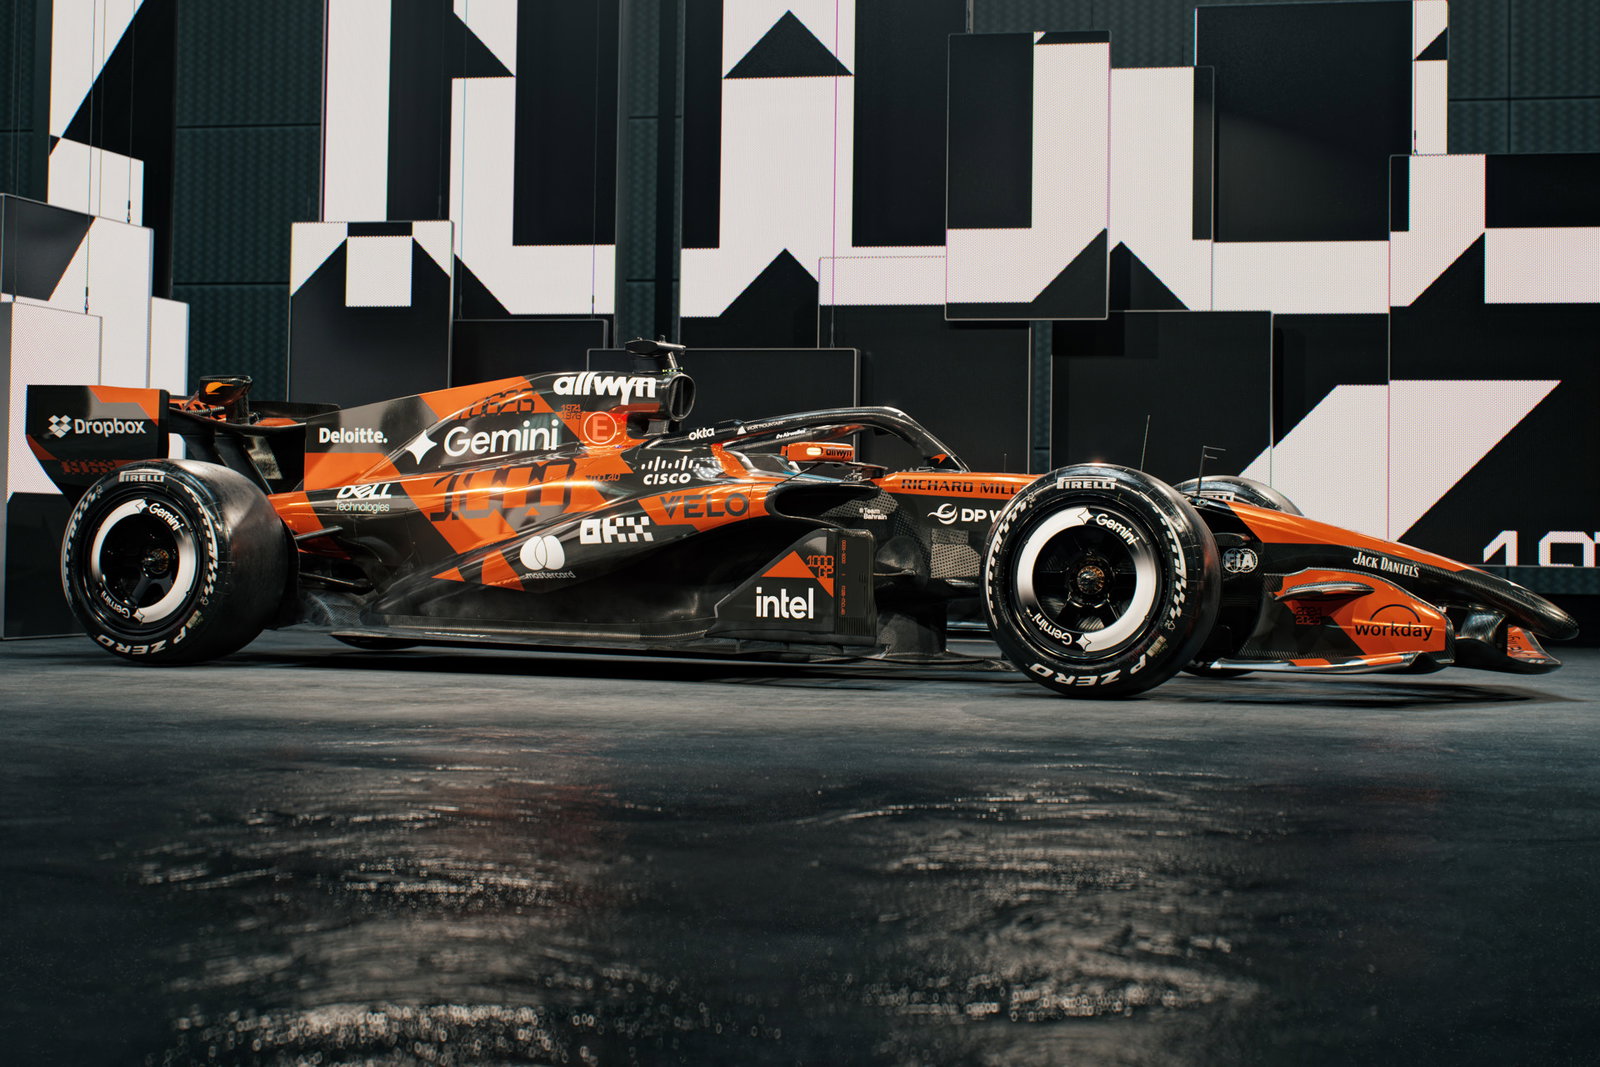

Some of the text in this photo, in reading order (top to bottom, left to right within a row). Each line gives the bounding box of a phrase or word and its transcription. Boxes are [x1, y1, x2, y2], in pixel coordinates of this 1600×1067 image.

[553, 372, 657, 405] allwyn
[74, 417, 147, 437] Dropbox
[318, 427, 389, 444] Deloitte.
[443, 419, 559, 458] Gemini
[592, 415, 608, 441] E
[688, 427, 715, 441] okta
[825, 448, 852, 459] allwyn
[118, 469, 166, 482] PIRELLI
[901, 478, 1025, 495] RICHARD MILL
[1056, 476, 1117, 490] PIRELLI
[336, 483, 392, 499] DELL
[148, 502, 185, 532] Gemini
[336, 501, 390, 514] Technologies
[659, 492, 749, 519] VELO
[961, 508, 988, 522] DP
[579, 516, 655, 545] OKX
[1096, 512, 1140, 546] Gemini
[100, 590, 132, 620] Gemini
[755, 586, 814, 619] intel
[97, 625, 187, 655] P ZERO
[1031, 613, 1073, 646] Gemini
[1355, 621, 1433, 641] workday
[1029, 654, 1146, 687] P ZERO
